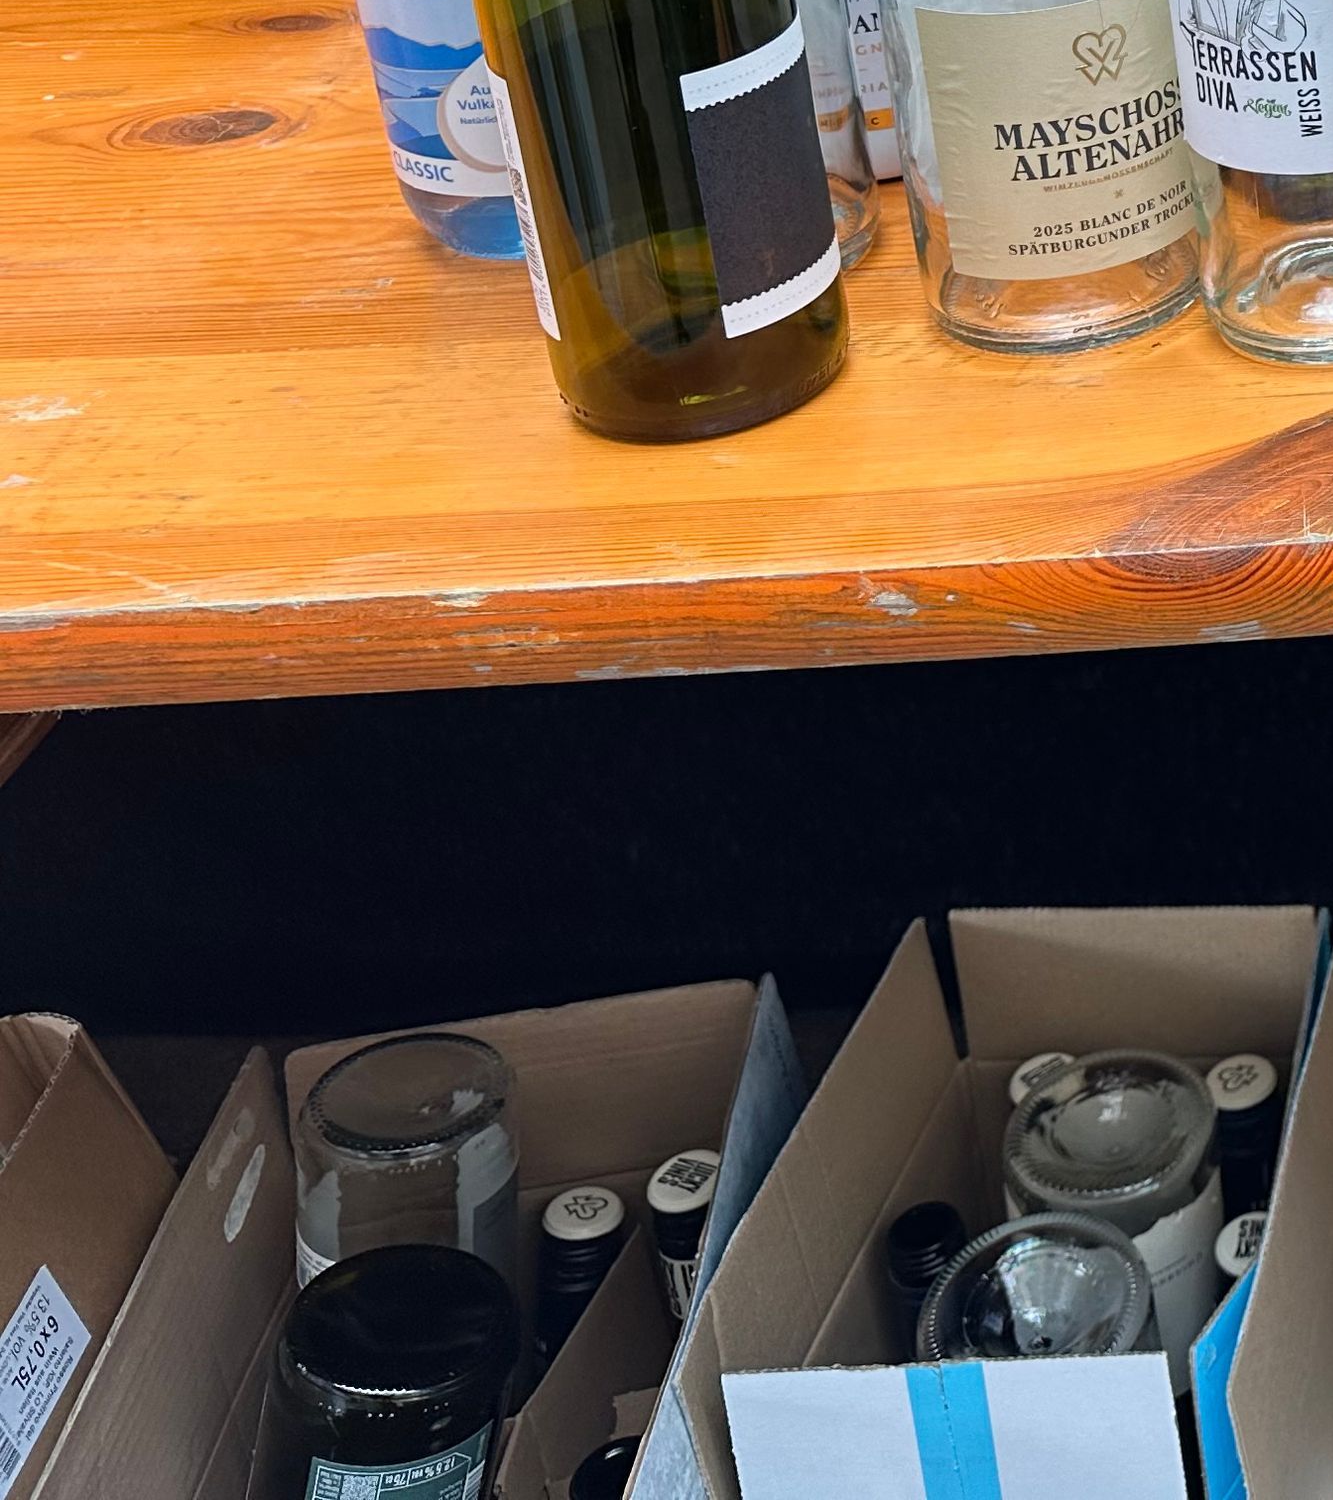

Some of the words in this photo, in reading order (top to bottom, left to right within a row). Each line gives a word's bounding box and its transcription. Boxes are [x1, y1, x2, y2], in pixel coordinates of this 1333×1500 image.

[1190, 30, 1318, 83] TERRASSEN
[1196, 71, 1239, 114] DIVA
[1299, 87, 1324, 138] WEISS
[393, 150, 454, 183] CLASSIC
[1010, 105, 1185, 182] ALTENAHR
[1032, 221, 1074, 239] 2025
[1080, 206, 1132, 232] BLANC
[1136, 197, 1156, 214] DE
[1159, 179, 1187, 206] NOIR
[1008, 216, 1151, 257] SPÄTBURGUNDER
